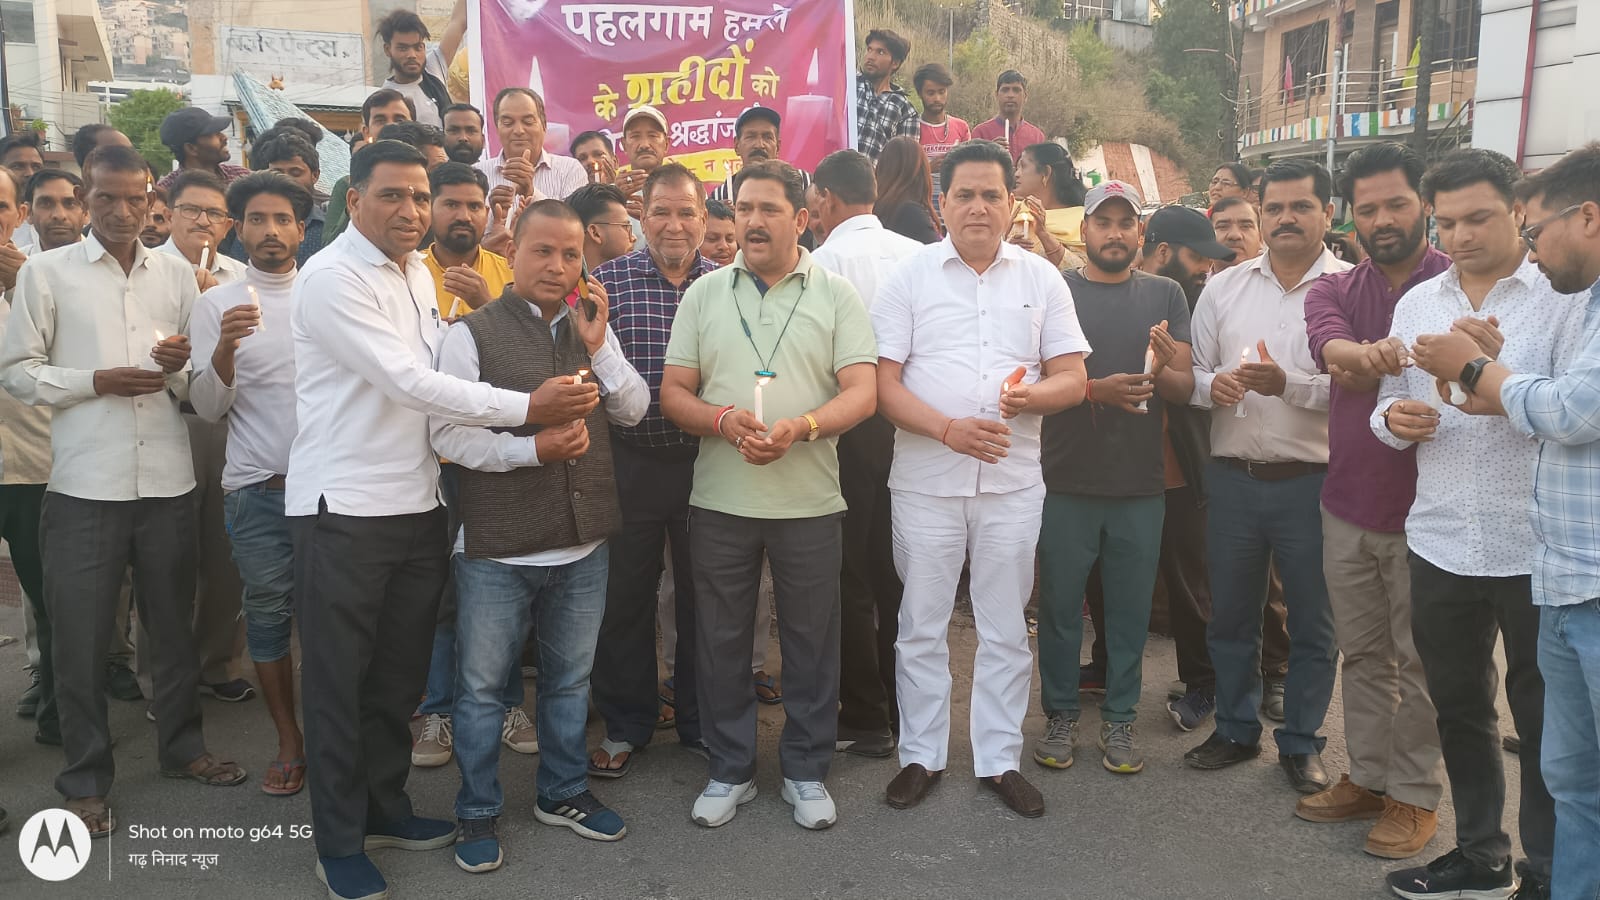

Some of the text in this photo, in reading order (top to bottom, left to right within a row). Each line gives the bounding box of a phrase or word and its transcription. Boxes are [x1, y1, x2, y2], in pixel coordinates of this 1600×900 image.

[561, 3, 791, 46] पहलगाम हमले
[593, 83, 619, 122] के
[750, 66, 780, 99] को
